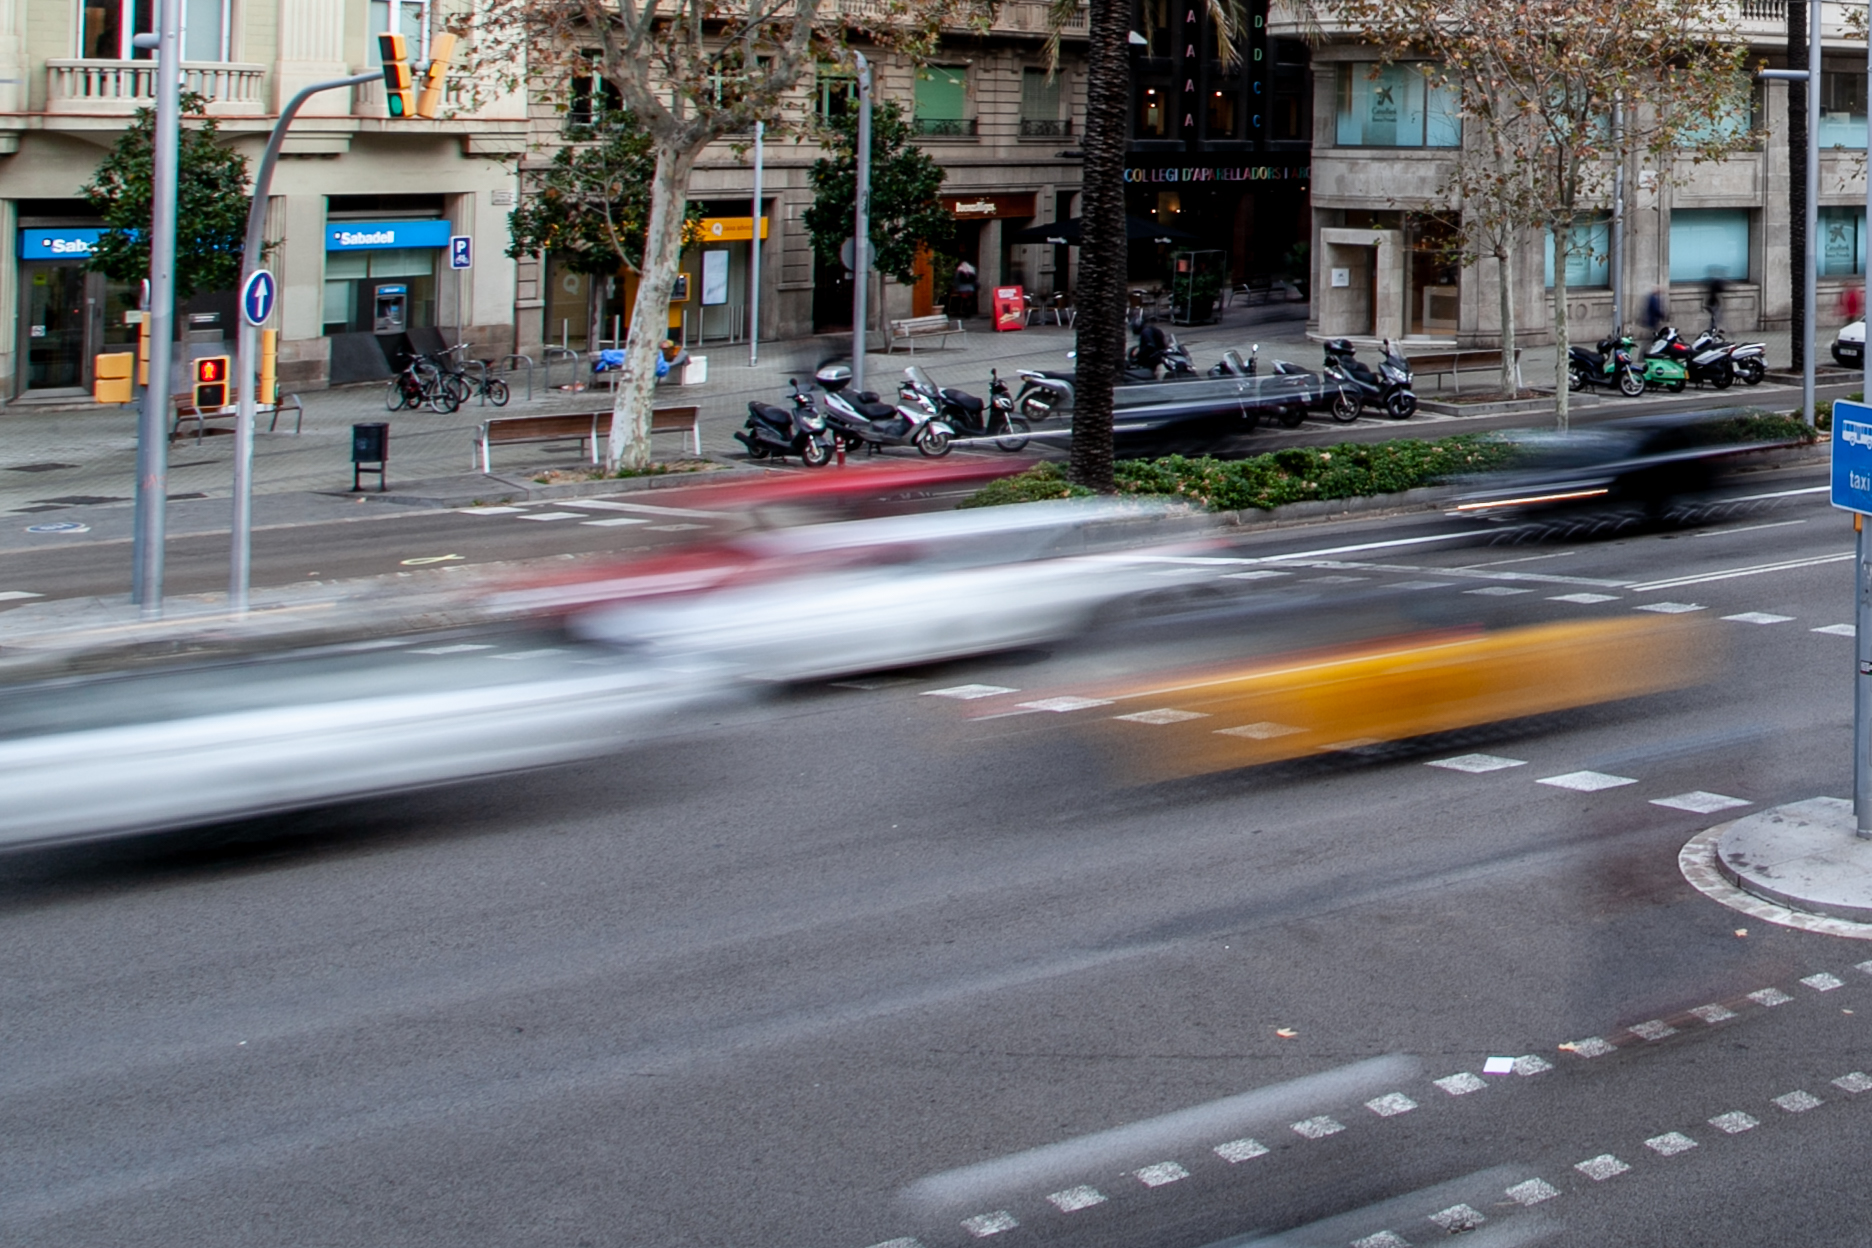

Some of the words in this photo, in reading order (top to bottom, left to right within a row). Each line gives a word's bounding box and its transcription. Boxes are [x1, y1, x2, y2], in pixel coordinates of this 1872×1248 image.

[340, 230, 395, 246] Sabadell
[457, 241, 467, 253] P
[1849, 470, 1870, 491] taxi
